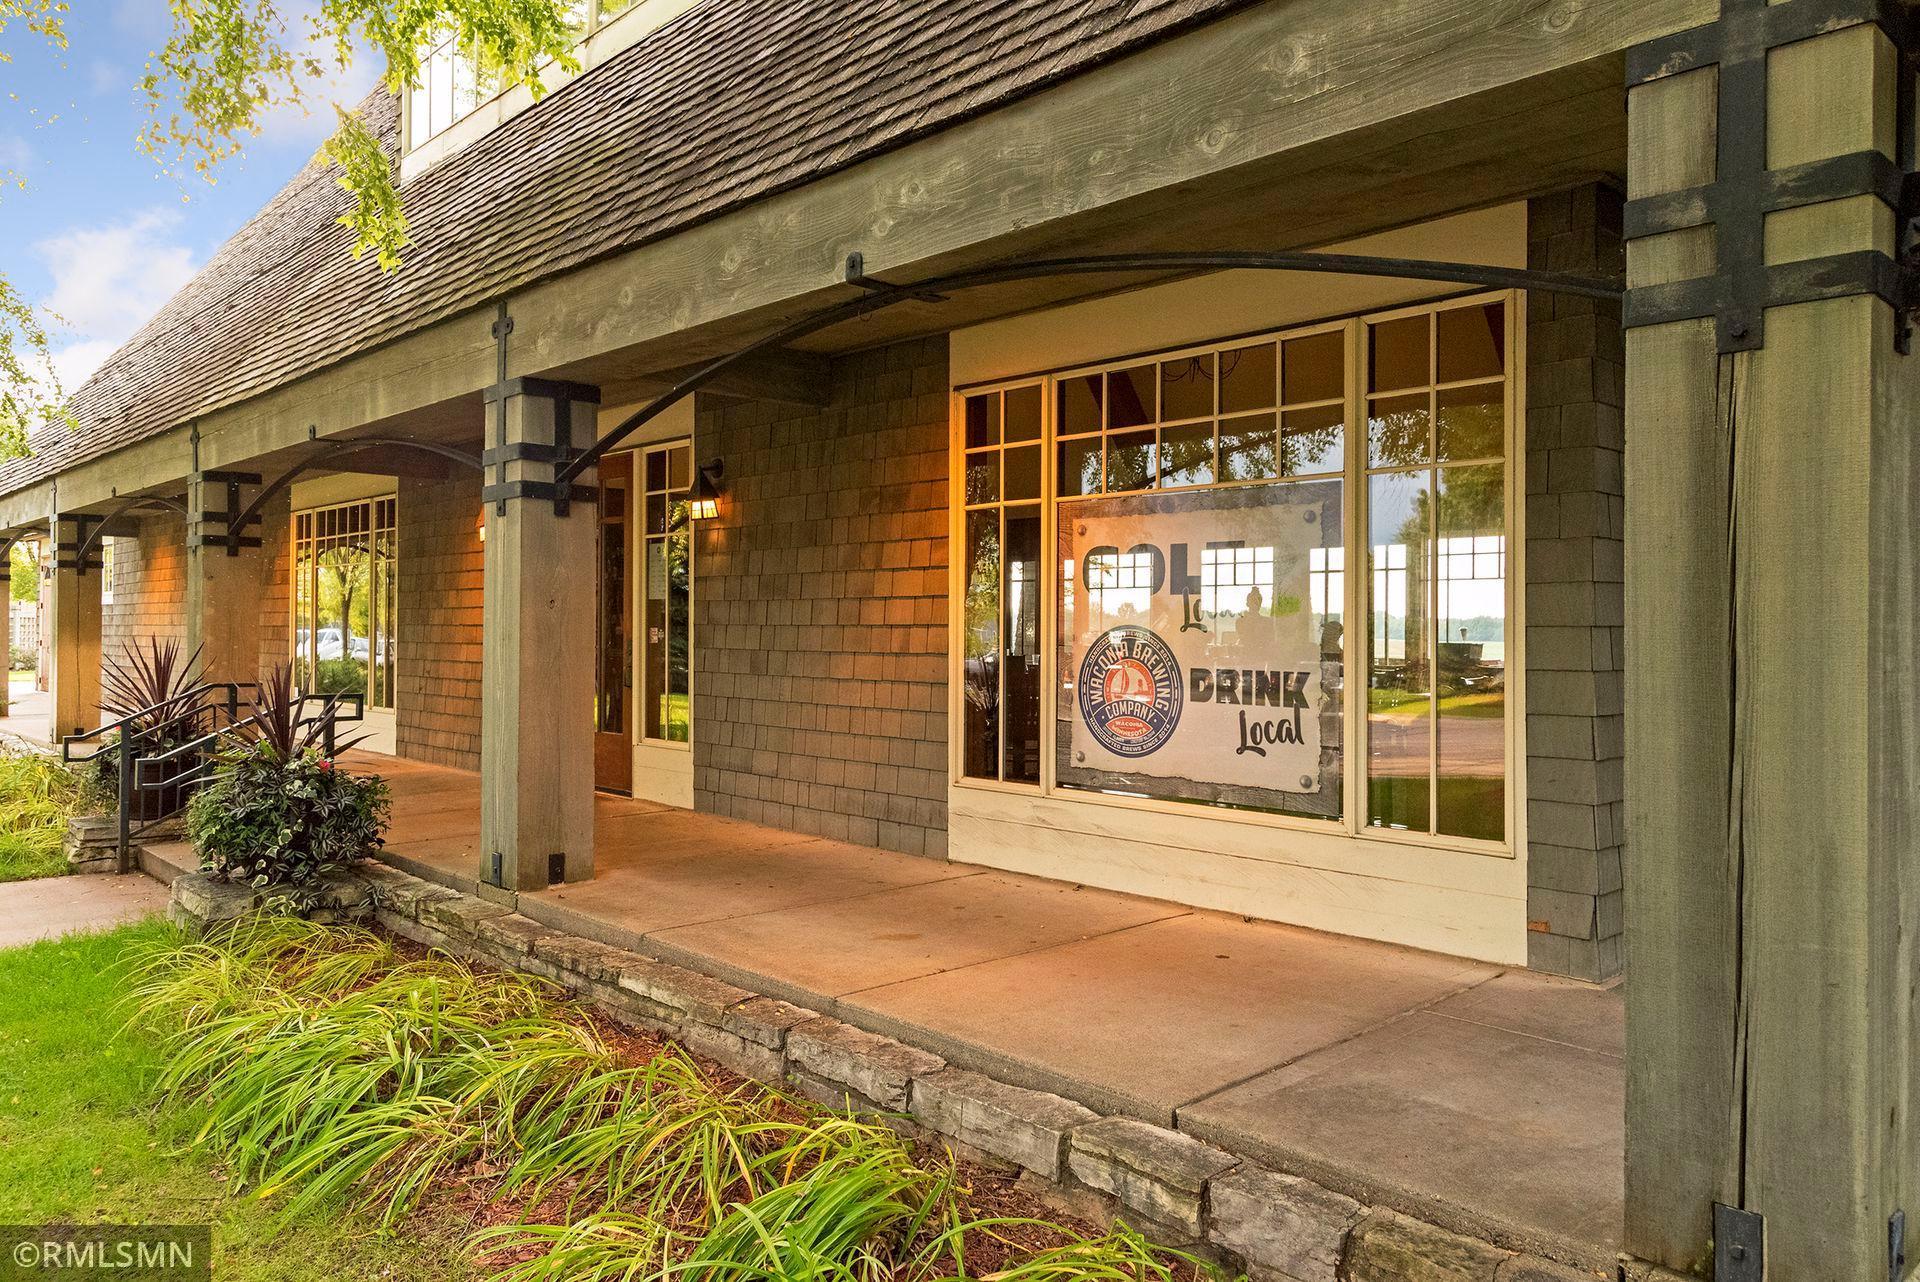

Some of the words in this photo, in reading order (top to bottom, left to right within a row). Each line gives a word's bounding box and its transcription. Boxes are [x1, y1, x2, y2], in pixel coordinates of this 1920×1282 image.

[1089, 641, 1129, 706] WACONIA
[1132, 640, 1171, 711] BREWING
[1190, 668, 1311, 709] DRINK
[1105, 701, 1155, 722] COMPANY
[1236, 702, 1305, 757] Local
[1090, 717, 1121, 749] HANDCRAFTED
[1143, 738, 1159, 749] SINCE
[1158, 724, 1171, 739] 2014
[1111, 725, 1147, 737] MINNESOTA
